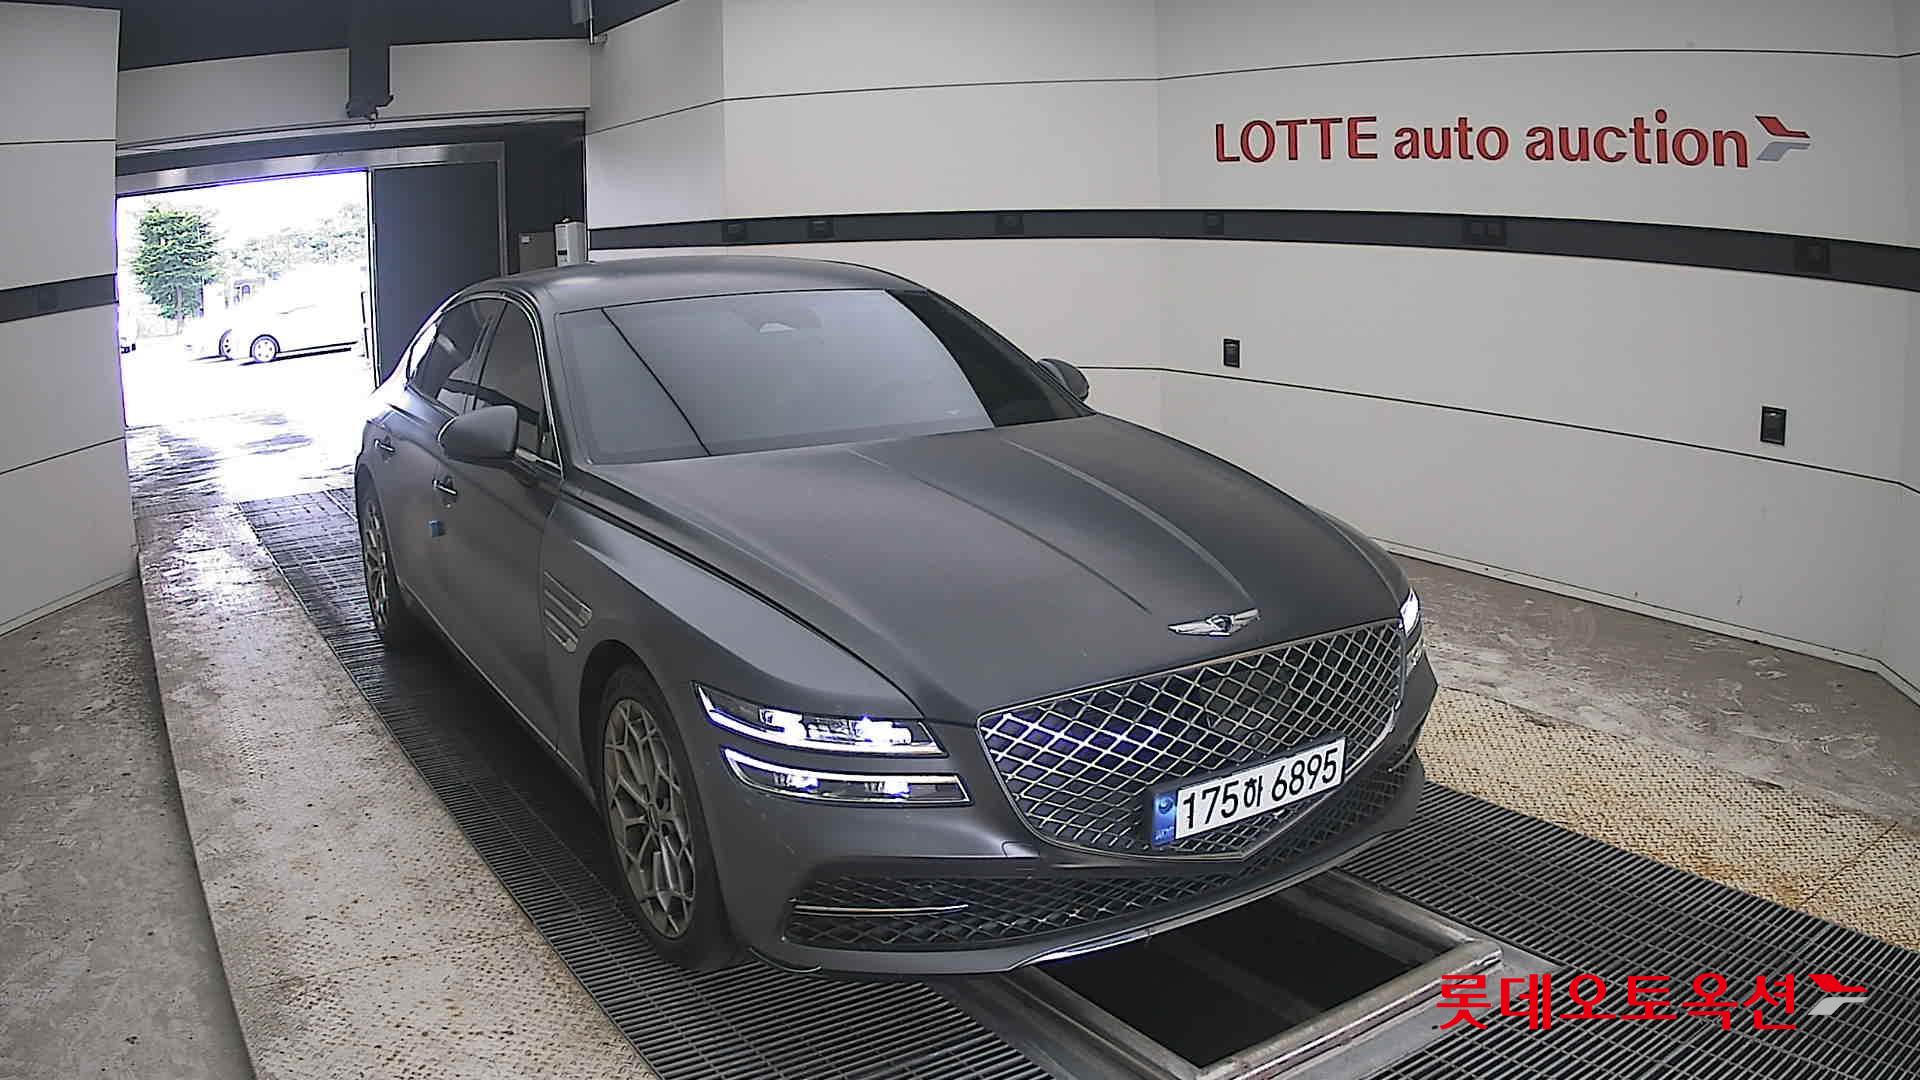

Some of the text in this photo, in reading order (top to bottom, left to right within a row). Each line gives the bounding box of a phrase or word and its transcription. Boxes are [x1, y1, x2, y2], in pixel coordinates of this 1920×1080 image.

[1214, 109, 1750, 169] LOTTE auto auction
[1183, 749, 1338, 830] 175하 6895
